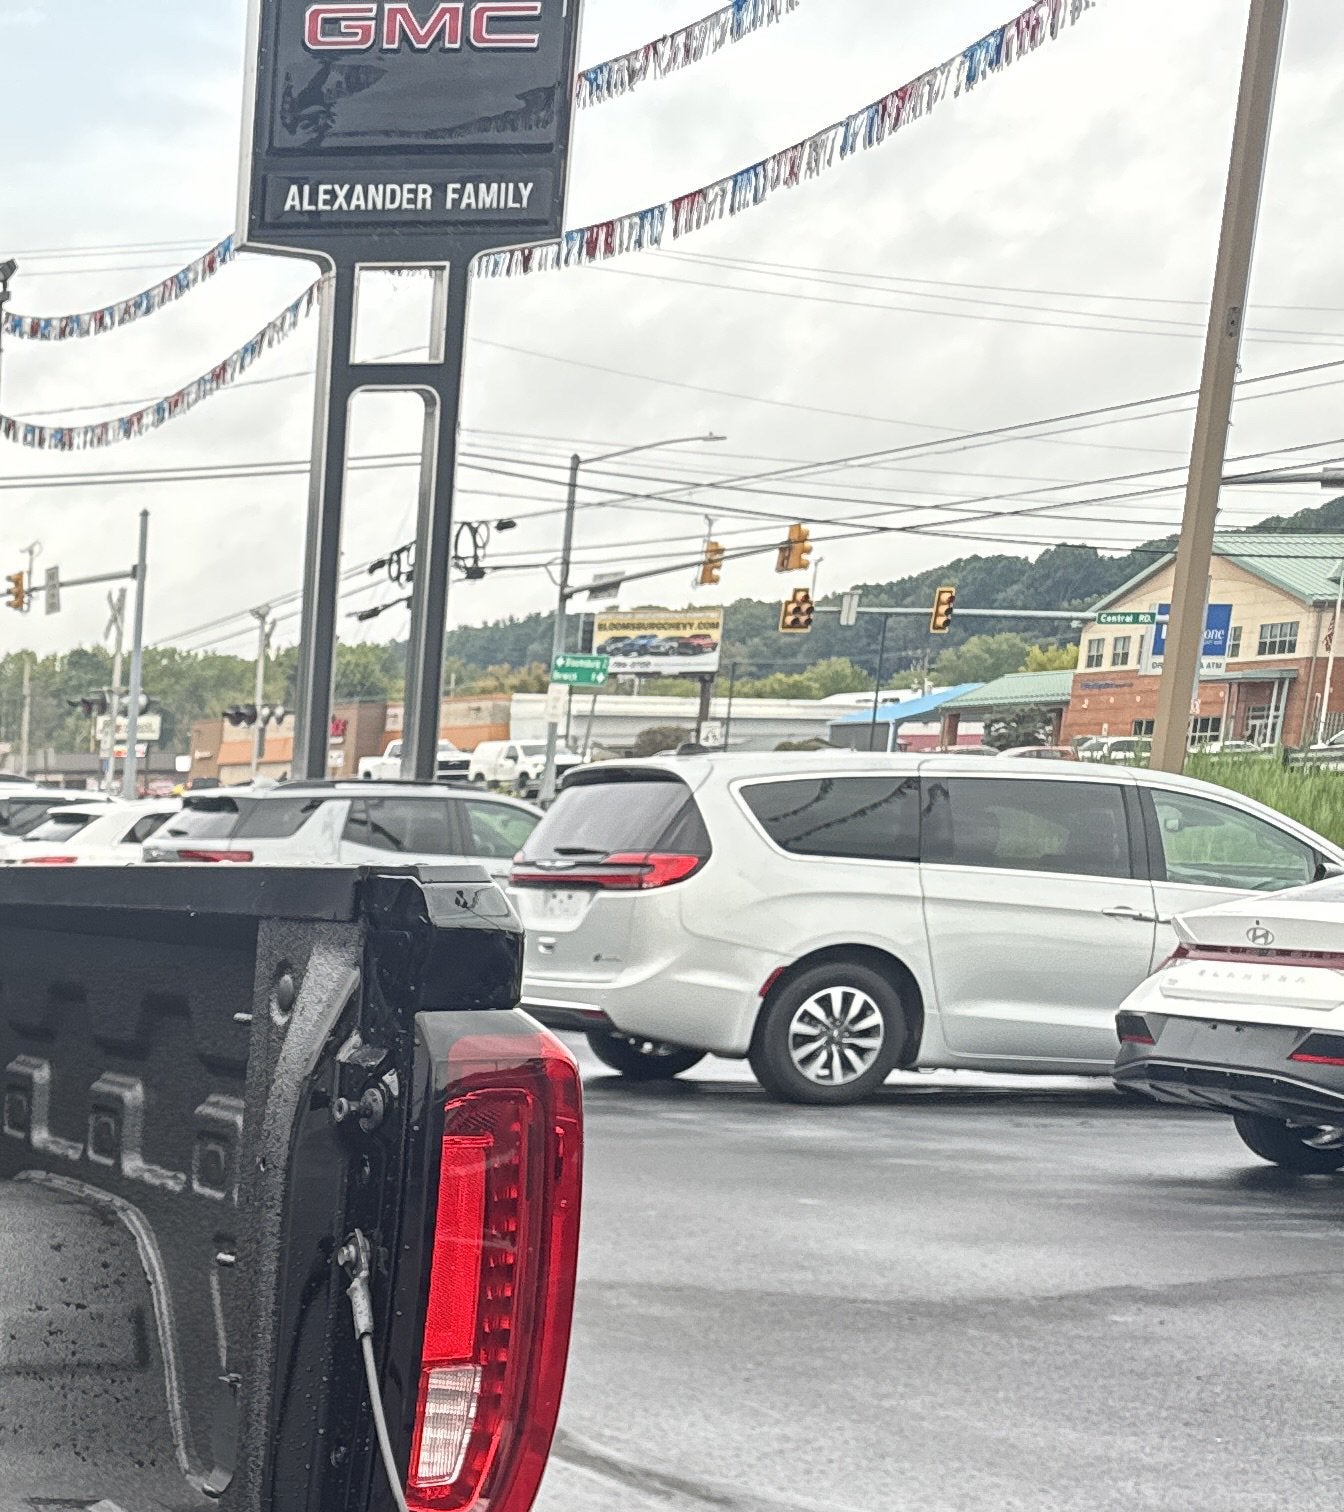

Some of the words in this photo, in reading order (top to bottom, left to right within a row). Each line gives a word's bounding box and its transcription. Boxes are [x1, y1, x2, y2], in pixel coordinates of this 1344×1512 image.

[304, 2, 542, 50] GMC
[284, 183, 432, 211] ALEXANDER
[446, 182, 534, 210] FAMILY
[1100, 613, 1133, 623] Central
